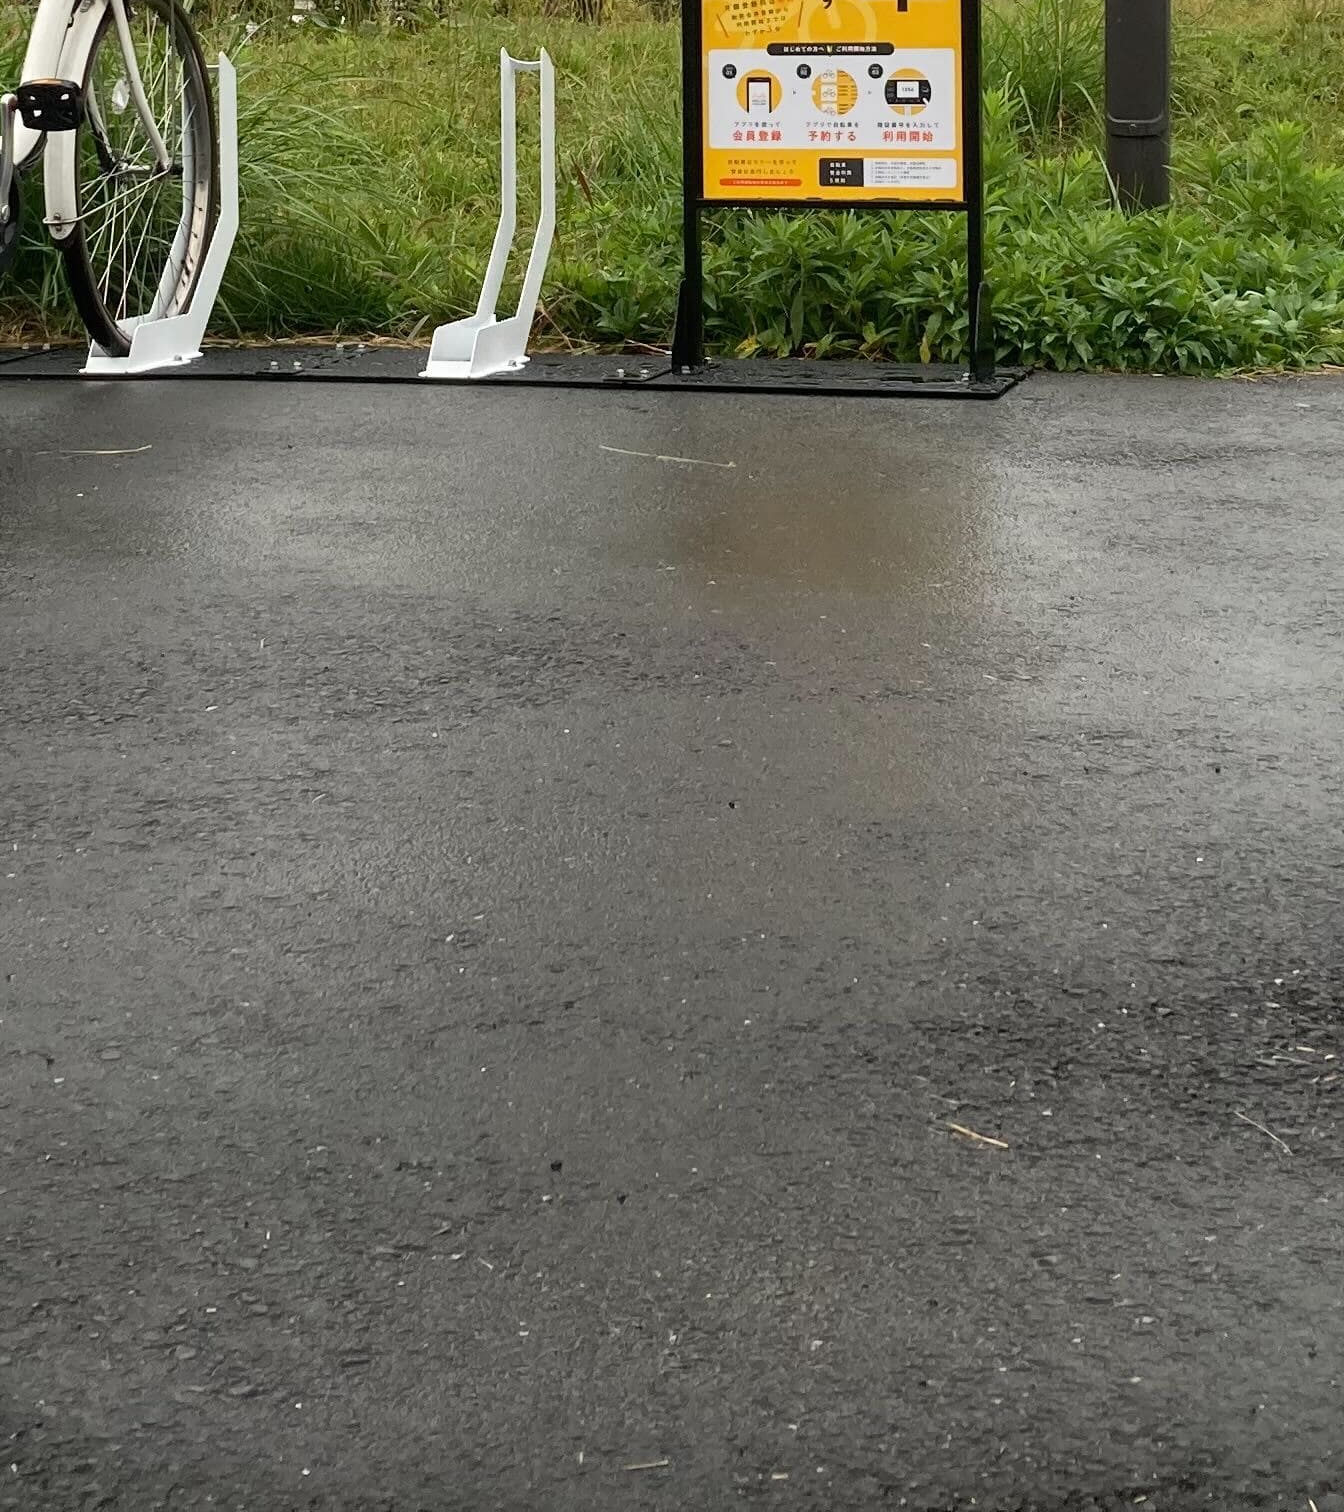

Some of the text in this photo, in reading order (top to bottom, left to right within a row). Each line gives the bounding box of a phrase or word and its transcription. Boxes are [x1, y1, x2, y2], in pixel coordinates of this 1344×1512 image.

[732, 130, 782, 142] 会員登録
[808, 130, 857, 142] 予約する
[882, 130, 934, 143] 利用開始
